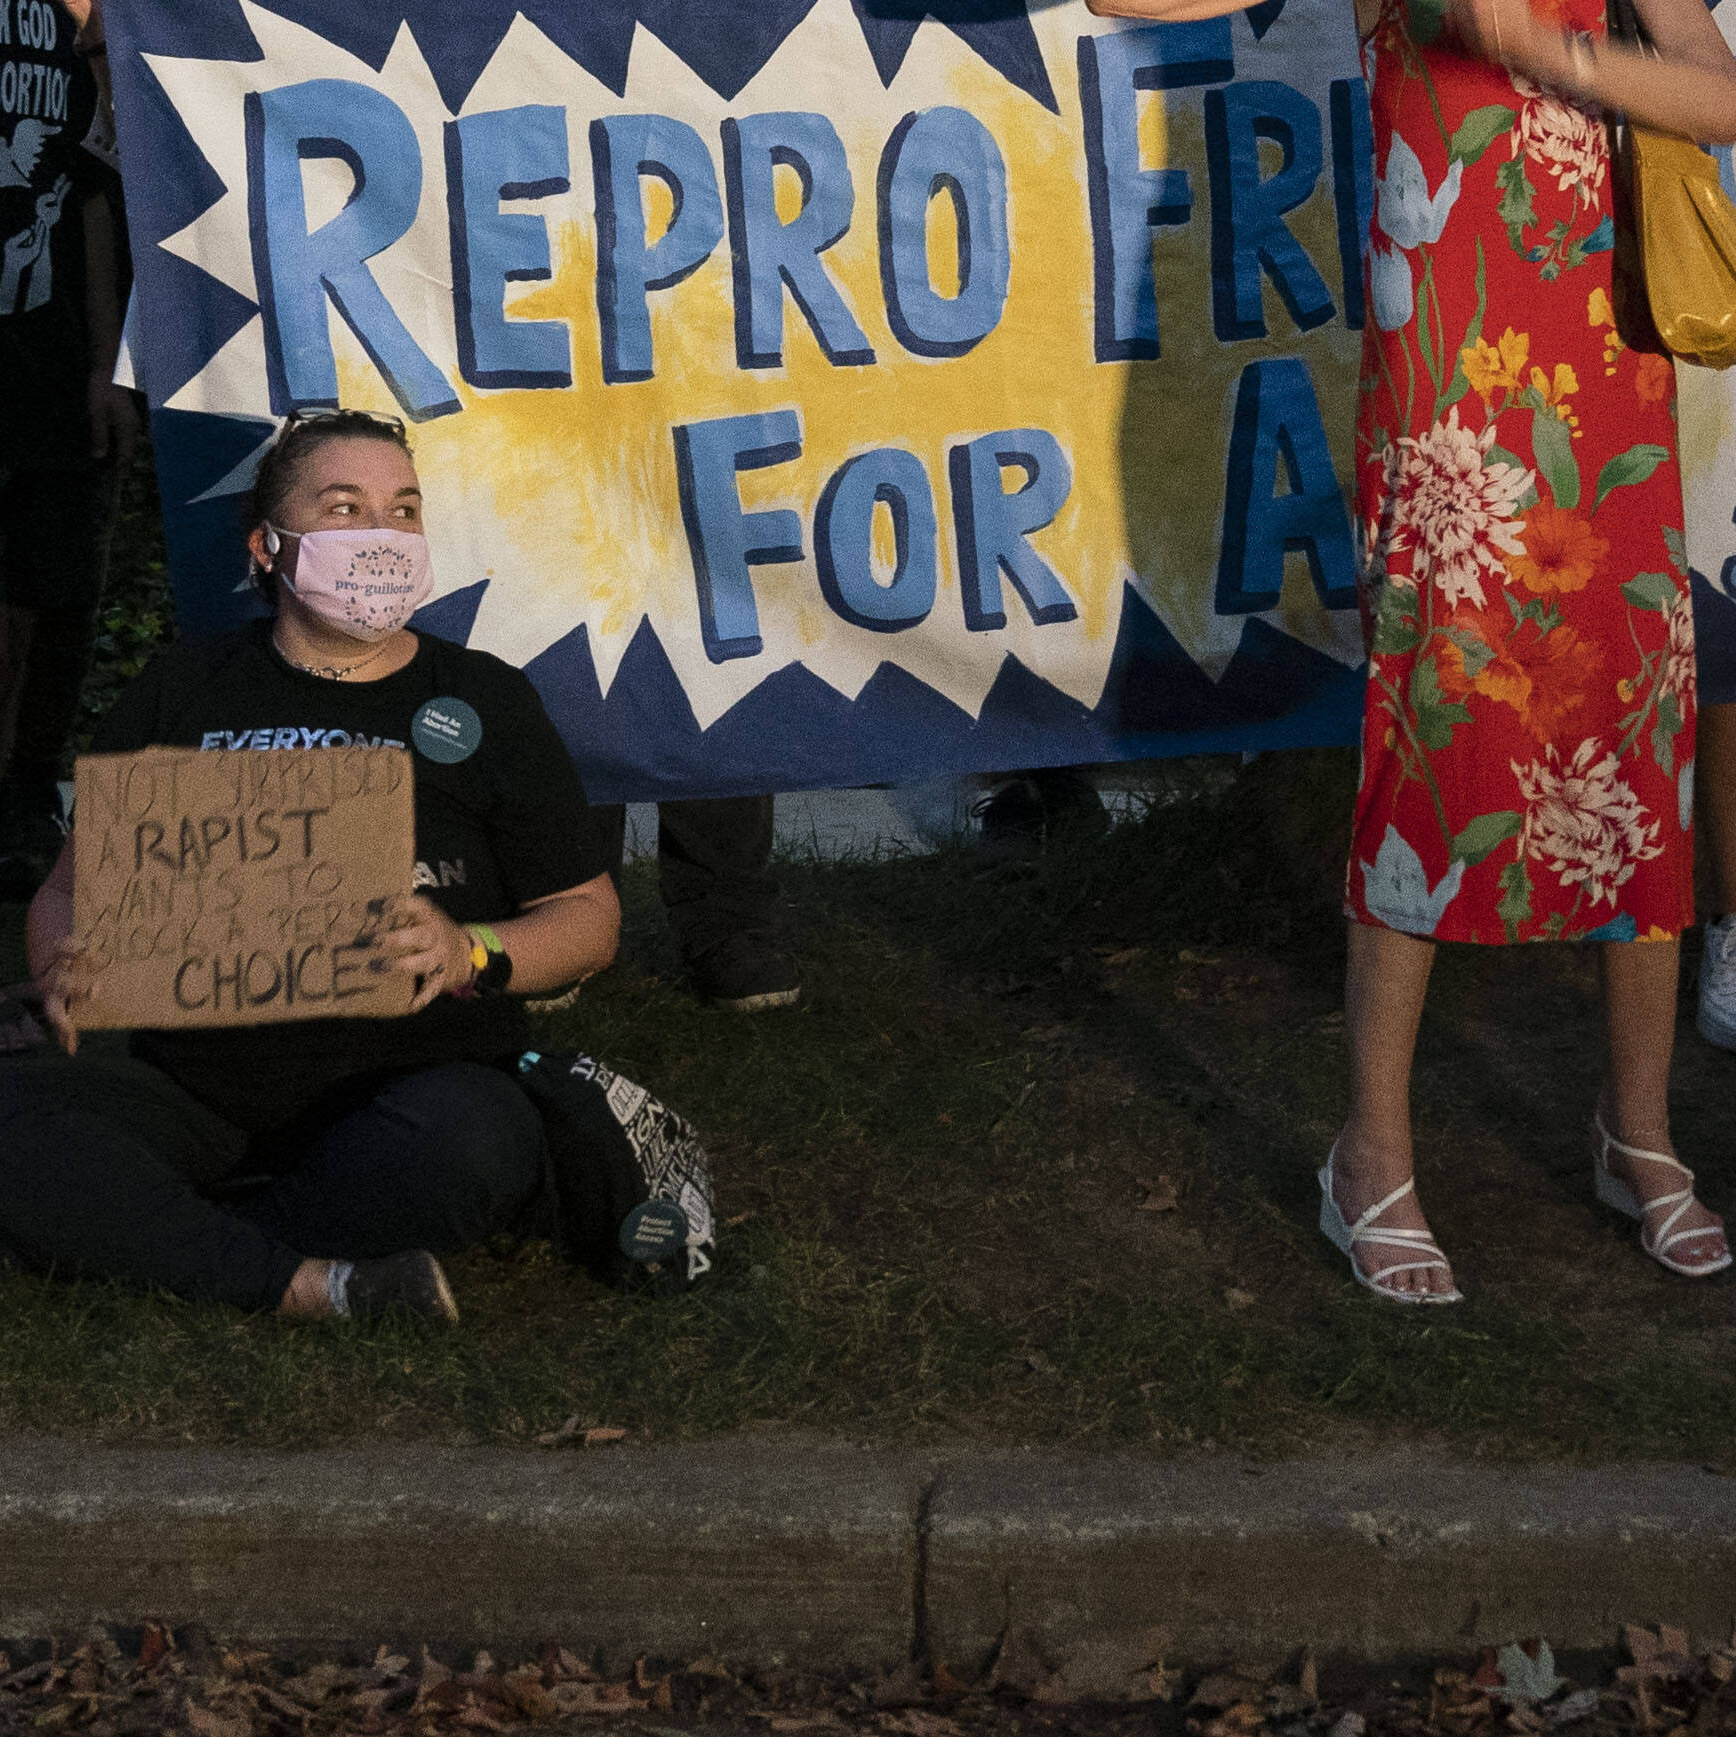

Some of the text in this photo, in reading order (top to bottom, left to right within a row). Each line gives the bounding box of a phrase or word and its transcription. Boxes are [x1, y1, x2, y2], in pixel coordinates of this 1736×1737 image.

[242, 76, 1015, 423] REPRO
[672, 406, 1079, 665] FOR
[87, 759, 188, 826] NOT
[133, 807, 330, 871] RAPIST
[266, 859, 343, 900] TO
[173, 941, 379, 1012] CHOICE
